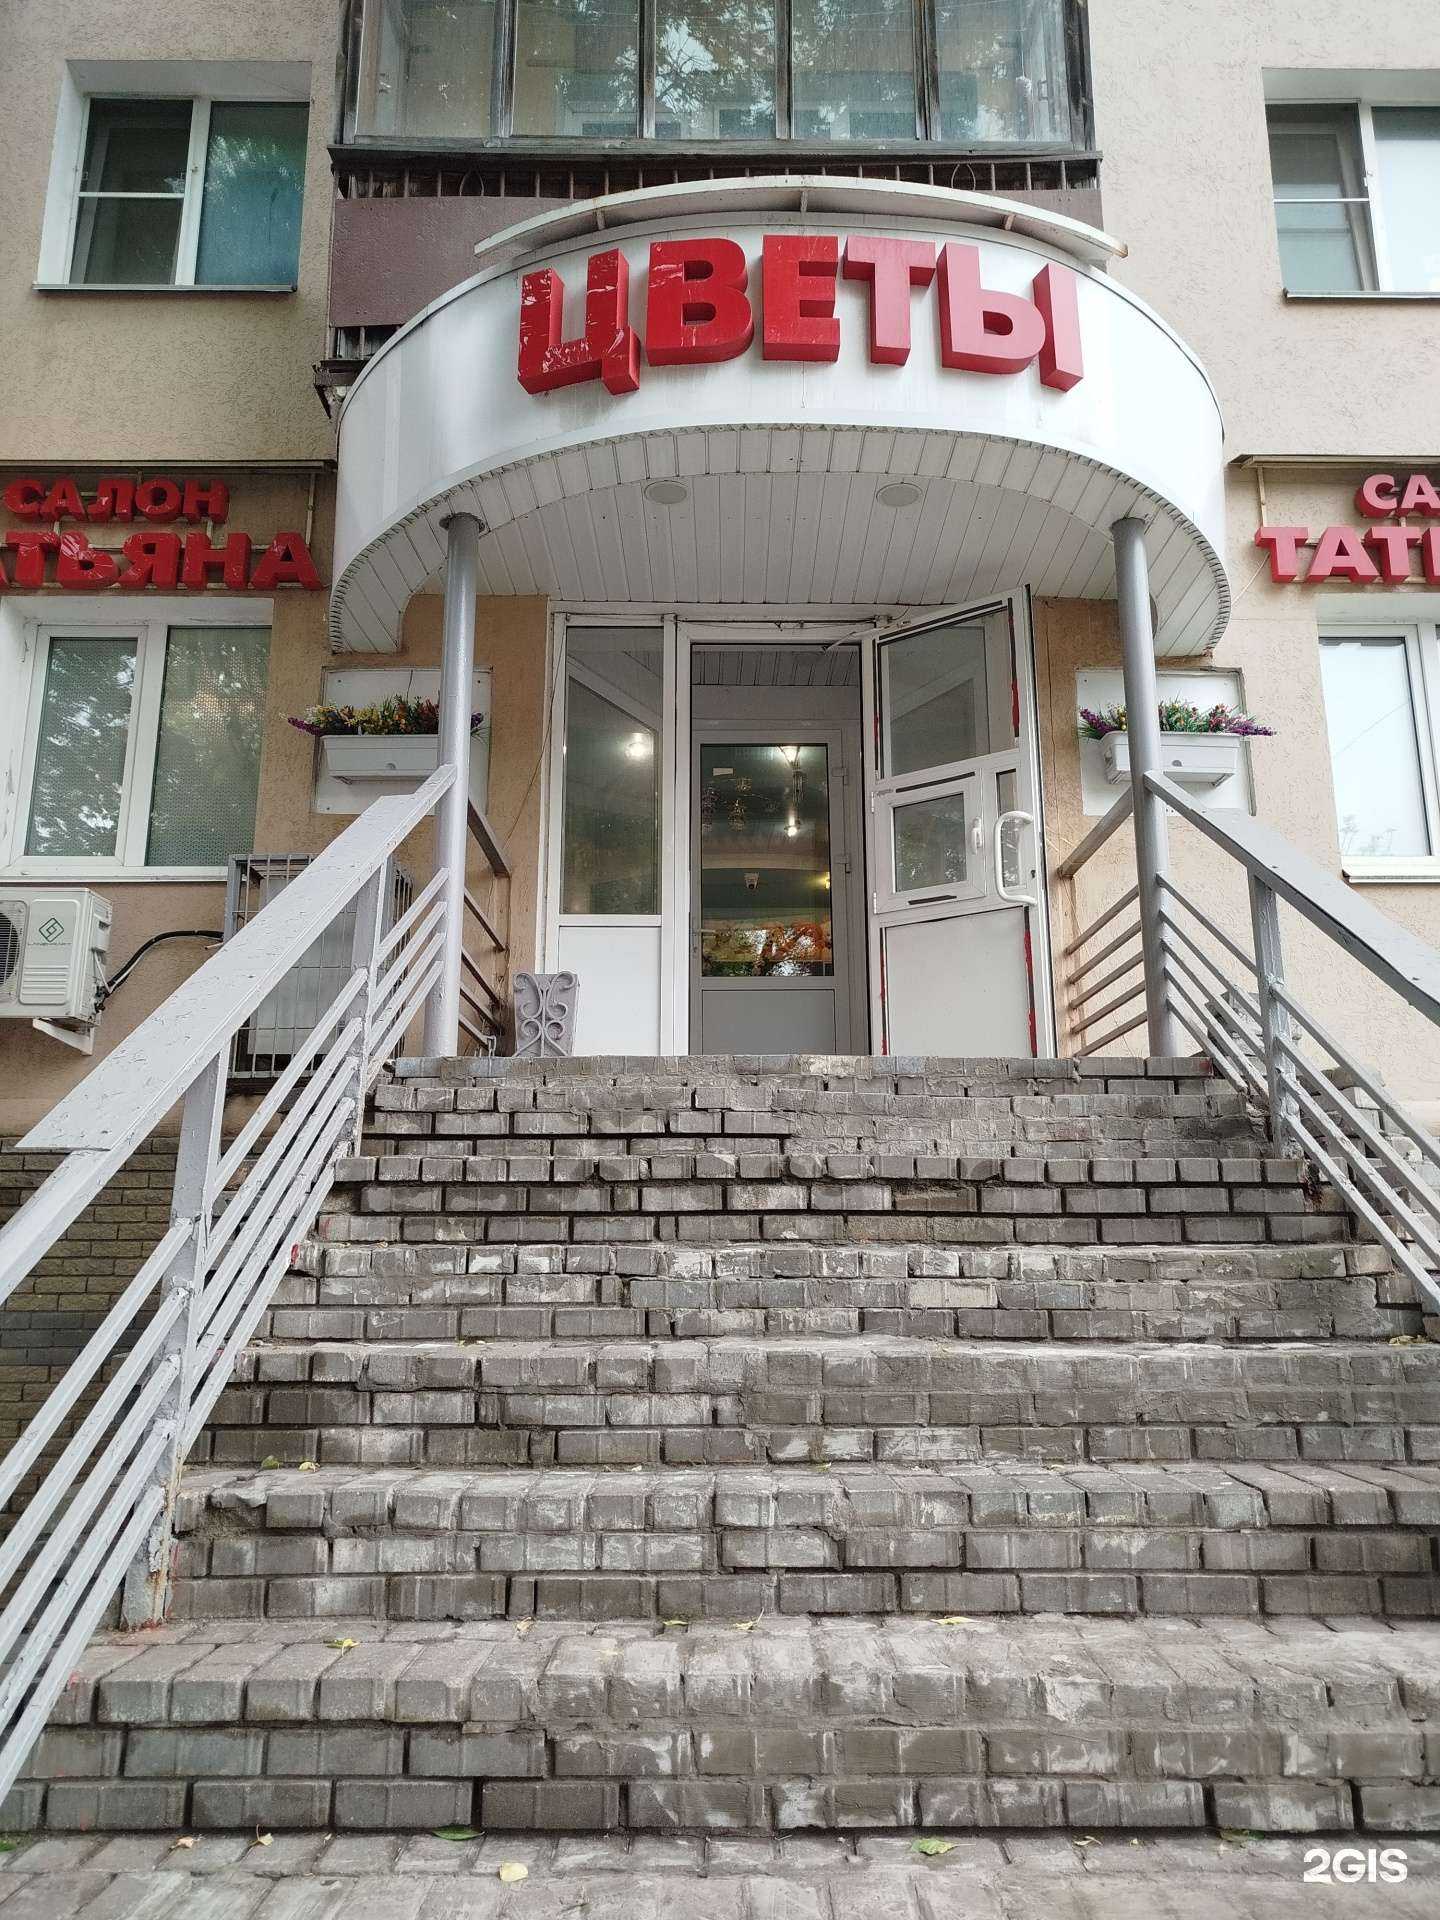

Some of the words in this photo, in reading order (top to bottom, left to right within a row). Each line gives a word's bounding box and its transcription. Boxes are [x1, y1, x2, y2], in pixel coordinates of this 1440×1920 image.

[518, 235, 1084, 395] ЦВЕТЫ
[1, 475, 230, 524] САЛОН
[0, 531, 325, 591] ТЬЯНА
